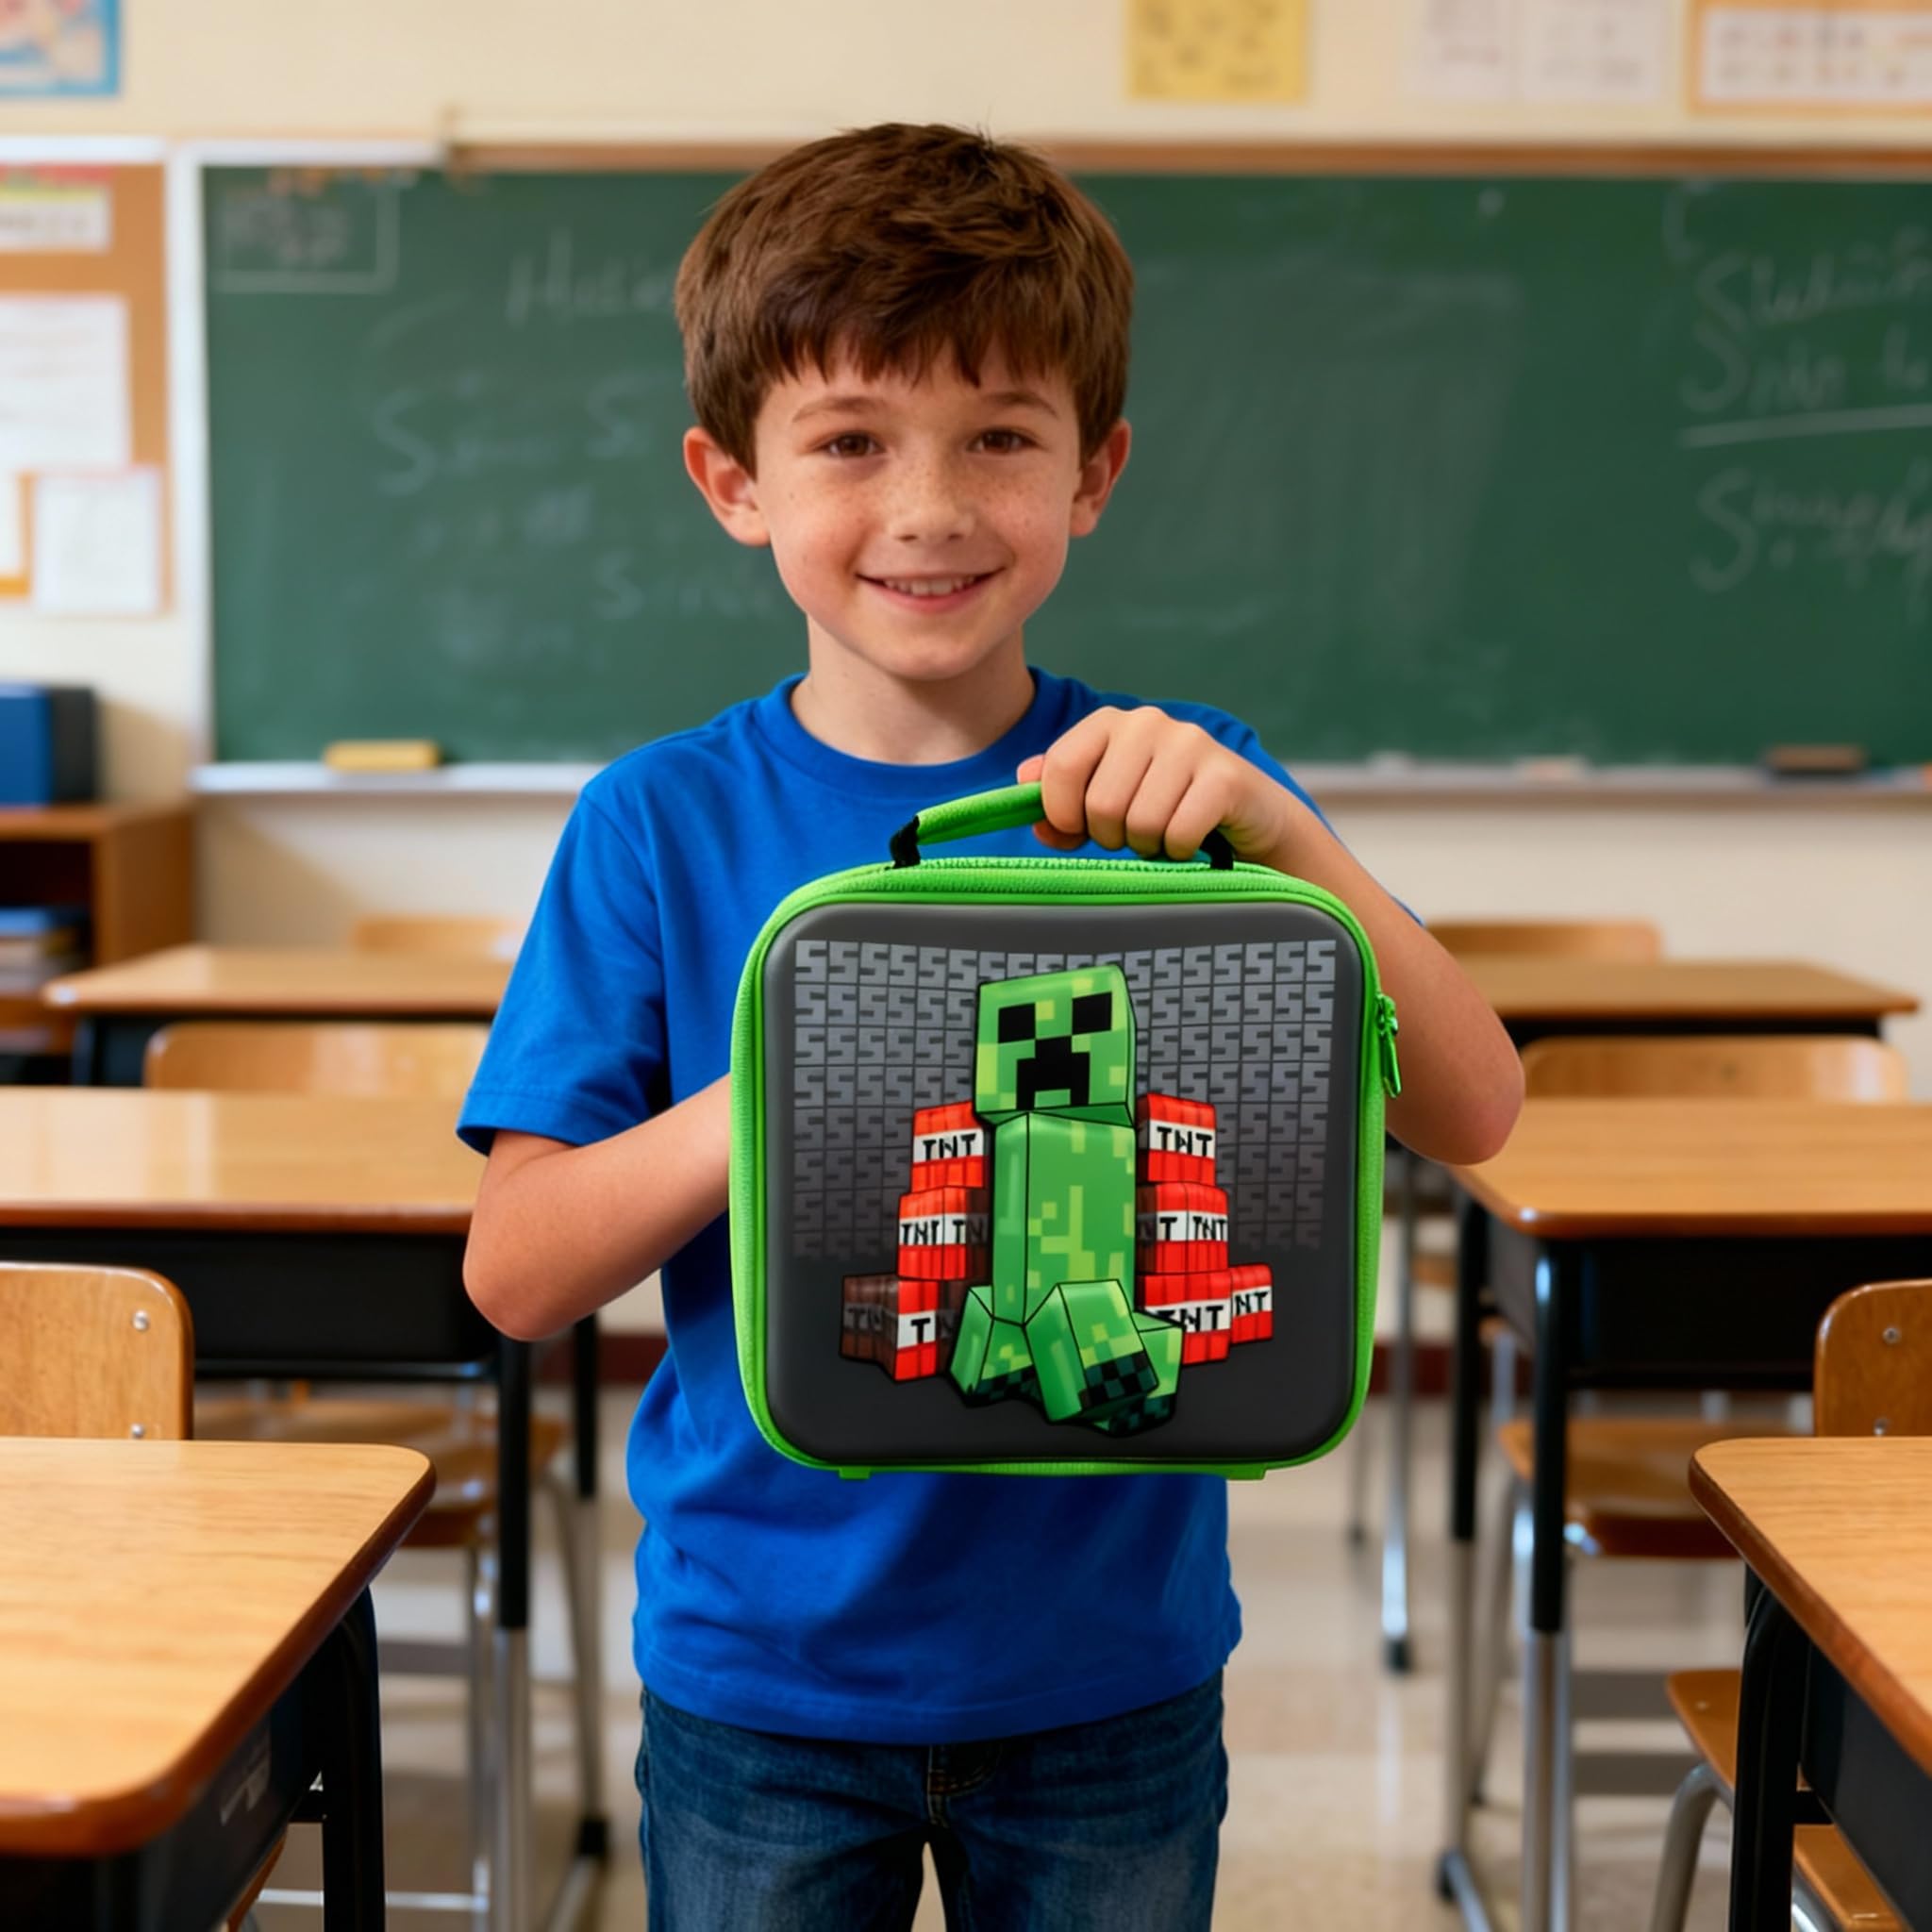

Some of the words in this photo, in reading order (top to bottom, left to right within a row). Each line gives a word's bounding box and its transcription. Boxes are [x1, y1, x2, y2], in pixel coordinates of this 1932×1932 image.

[923, 1133, 976, 1161] TNT
[1157, 1125, 1212, 1157] TNT
[901, 1220, 940, 1244] TNT
[1192, 1216, 1225, 1241] TNT
[1234, 1291, 1269, 1317] NT
